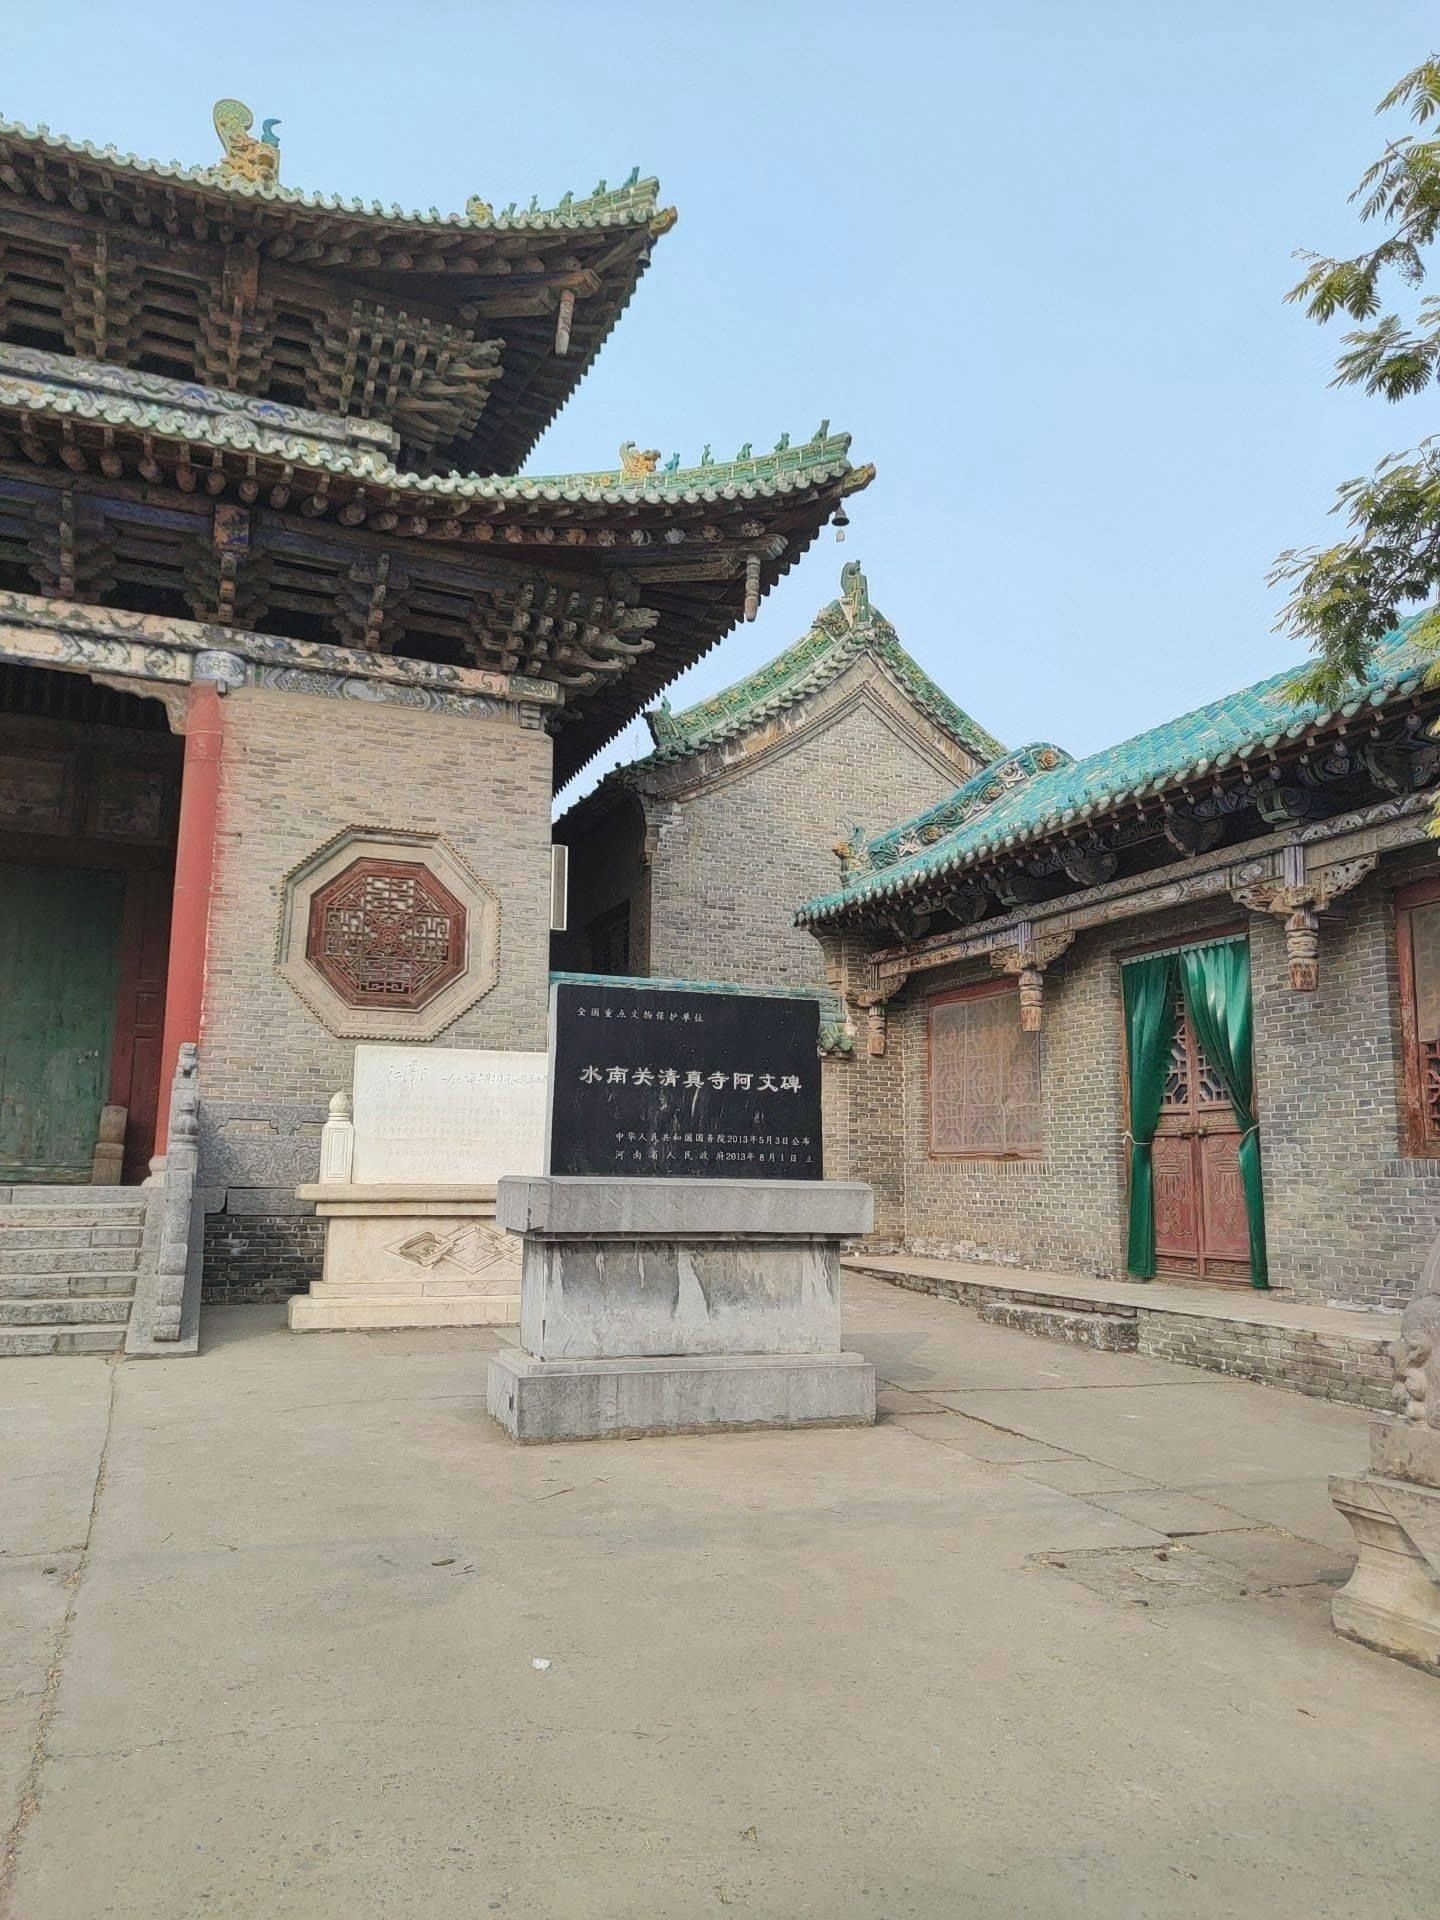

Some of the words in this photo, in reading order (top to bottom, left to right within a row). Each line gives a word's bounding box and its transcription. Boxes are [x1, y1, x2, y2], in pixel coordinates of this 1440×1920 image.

[577, 1006, 704, 1023] 全国重点文物保护单位
[578, 1065, 802, 1093] 水南关清真寺阿文碑
